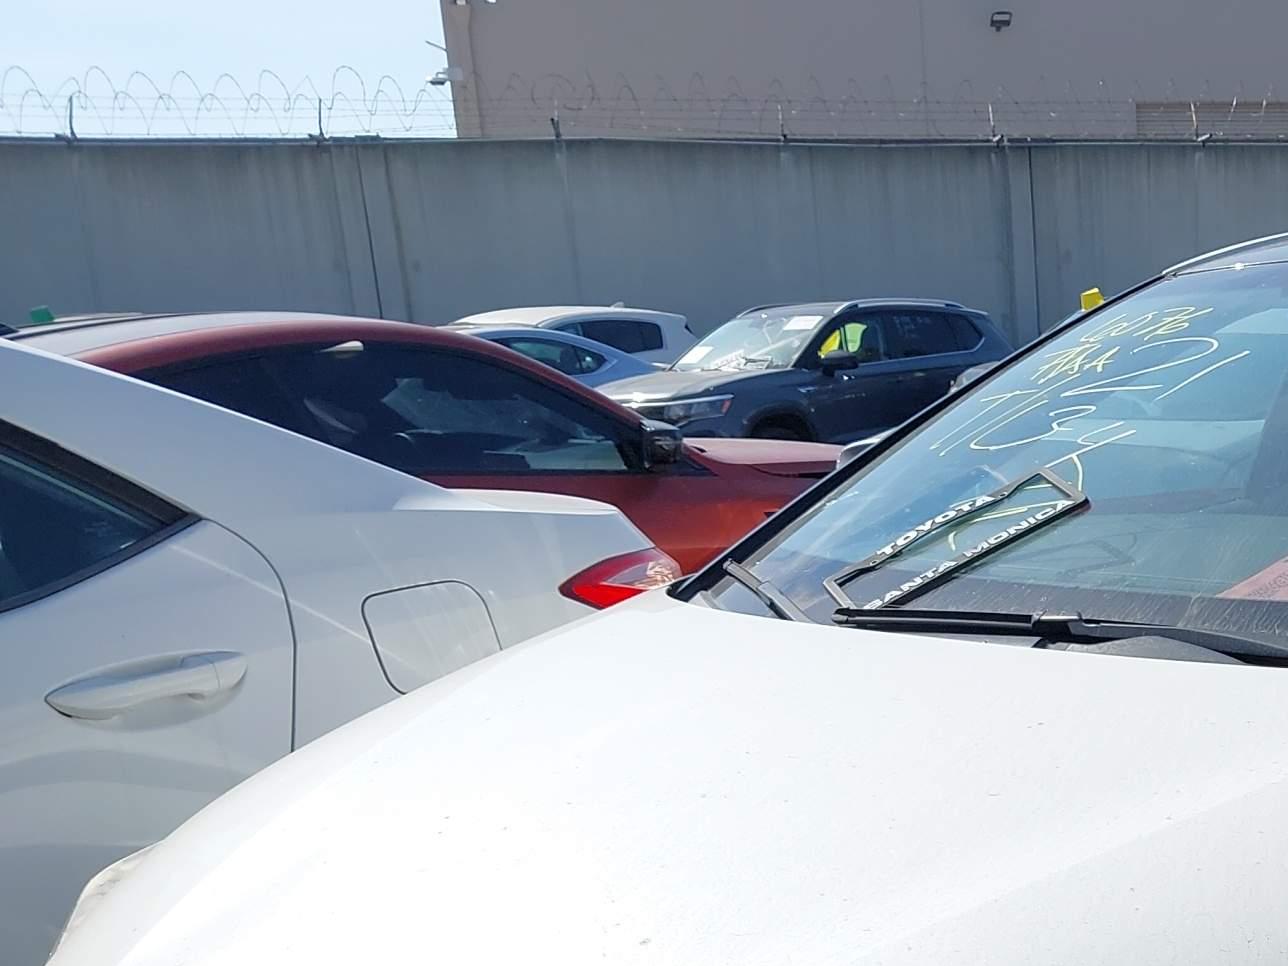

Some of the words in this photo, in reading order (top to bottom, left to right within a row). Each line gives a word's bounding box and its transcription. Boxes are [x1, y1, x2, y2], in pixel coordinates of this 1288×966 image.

[863, 560, 959, 610] SANTA
[963, 500, 1076, 557] MONICA
[876, 495, 997, 556] TOYOTA
